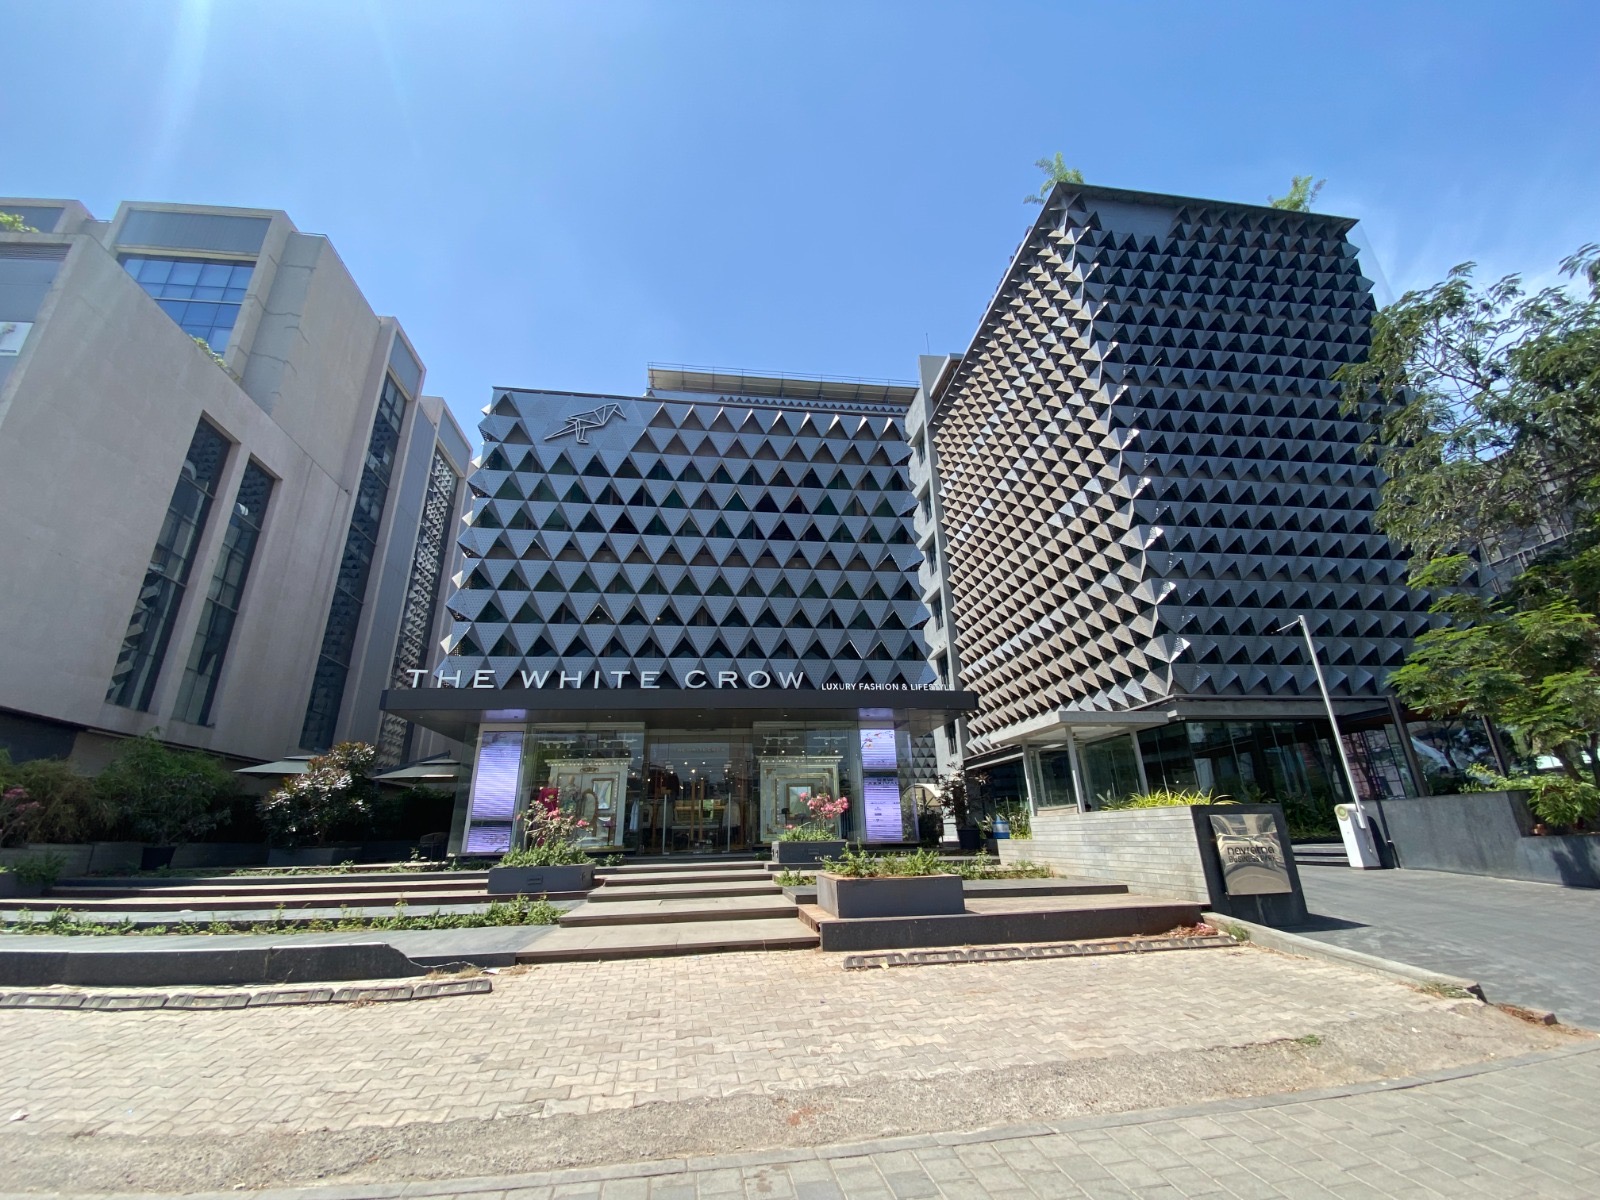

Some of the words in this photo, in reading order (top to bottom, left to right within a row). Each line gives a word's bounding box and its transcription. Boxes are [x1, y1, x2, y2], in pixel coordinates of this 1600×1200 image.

[406, 669, 496, 689] THE
[521, 670, 661, 689] WHITE
[684, 669, 804, 689] CROW
[821, 683, 857, 691] LUXURY
[859, 683, 899, 691] FASHION
[901, 683, 908, 691] &
[910, 683, 955, 692] LIFESTYLE
[1227, 845, 1275, 855] navratna
